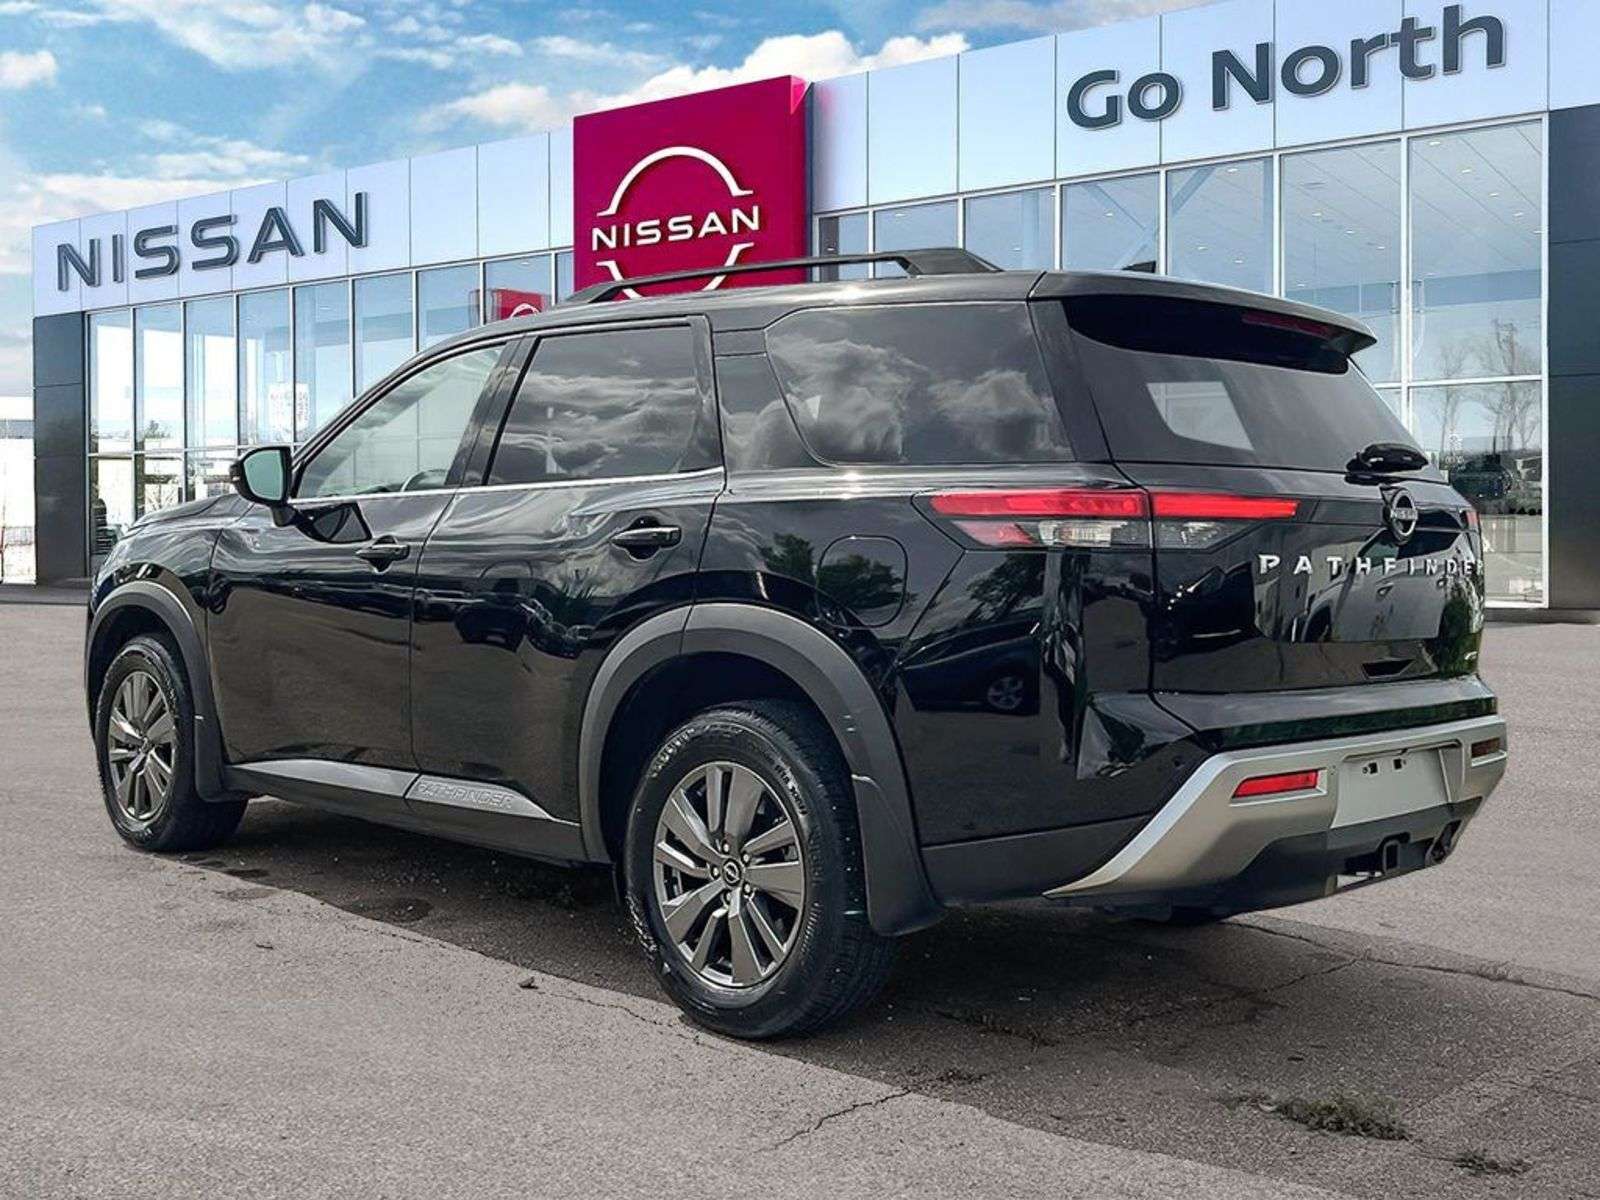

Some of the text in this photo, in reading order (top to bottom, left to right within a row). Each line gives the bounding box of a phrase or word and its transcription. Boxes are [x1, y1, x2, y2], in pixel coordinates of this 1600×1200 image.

[1067, 4, 1506, 130] Go North
[57, 192, 368, 291] NISSAN
[592, 205, 760, 251] NISSAN
